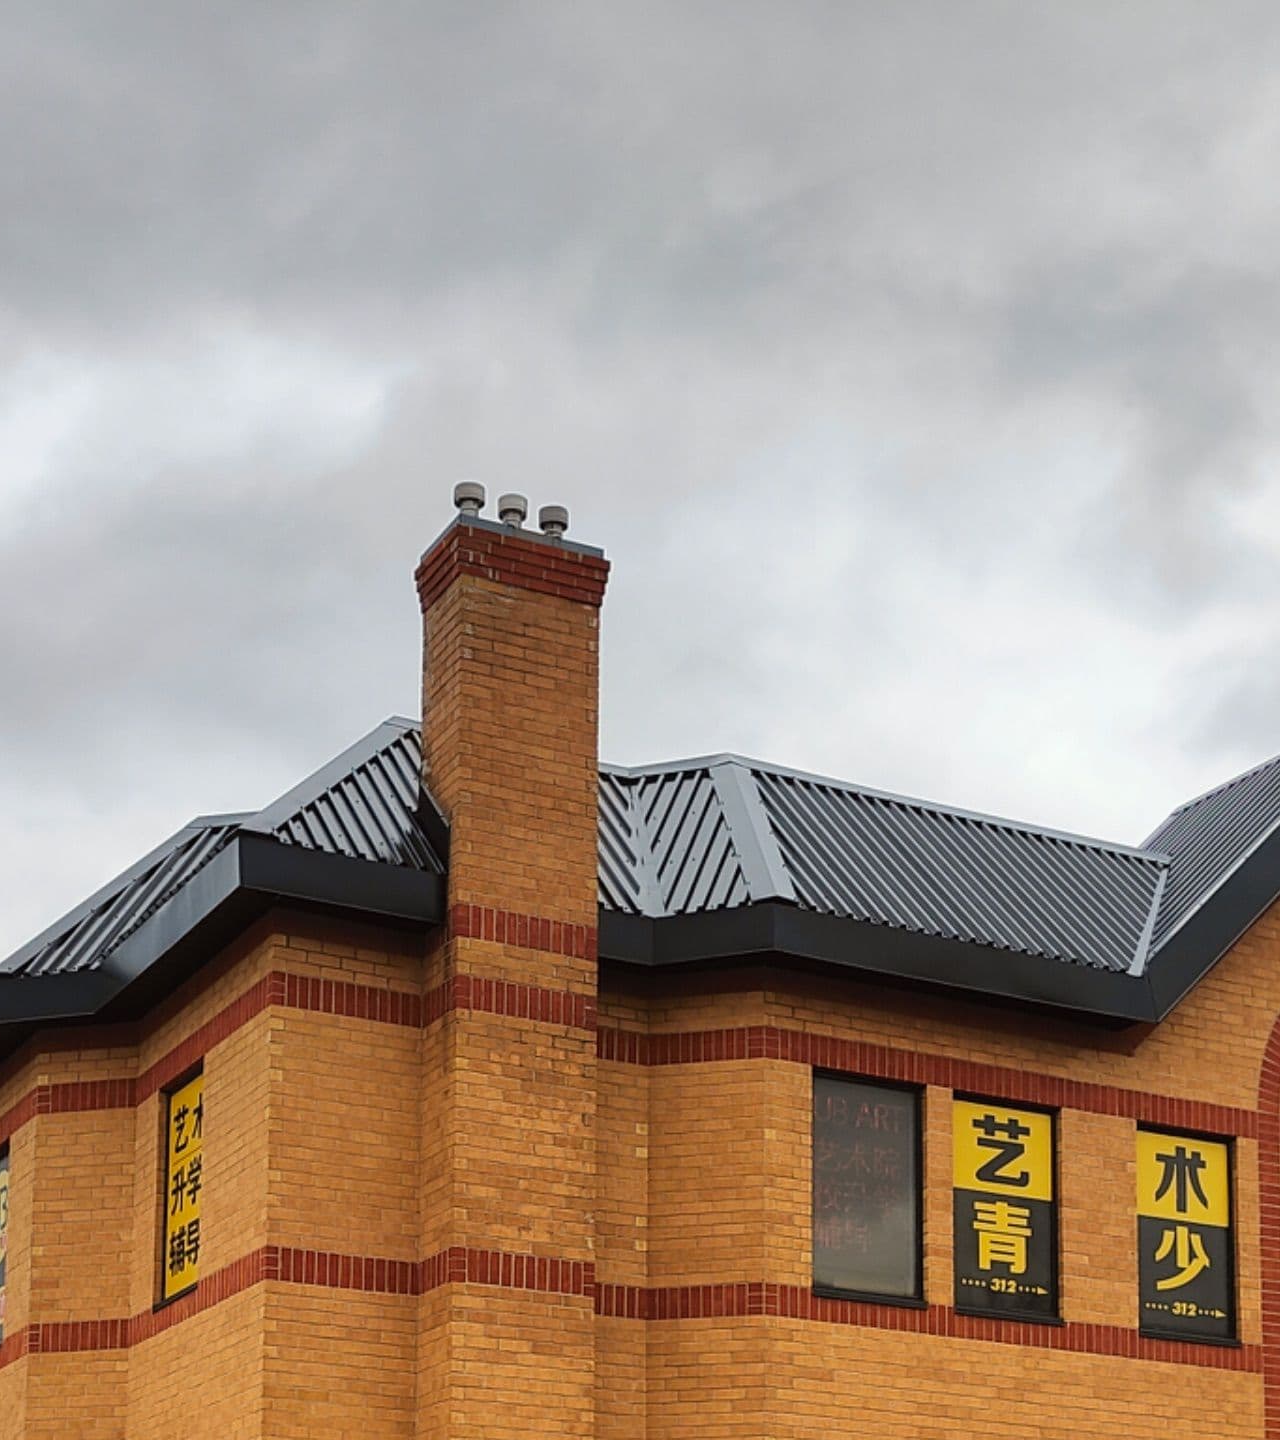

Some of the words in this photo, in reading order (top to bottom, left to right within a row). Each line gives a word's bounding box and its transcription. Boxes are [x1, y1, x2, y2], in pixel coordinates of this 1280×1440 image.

[972, 1114, 1030, 1188] 艺
[1155, 1146, 1209, 1213] 术
[973, 1201, 1032, 1274] 青
[1154, 1225, 1211, 1291] 少
[990, 1278, 1017, 1294] 312
[1172, 1301, 1197, 1317] 312
